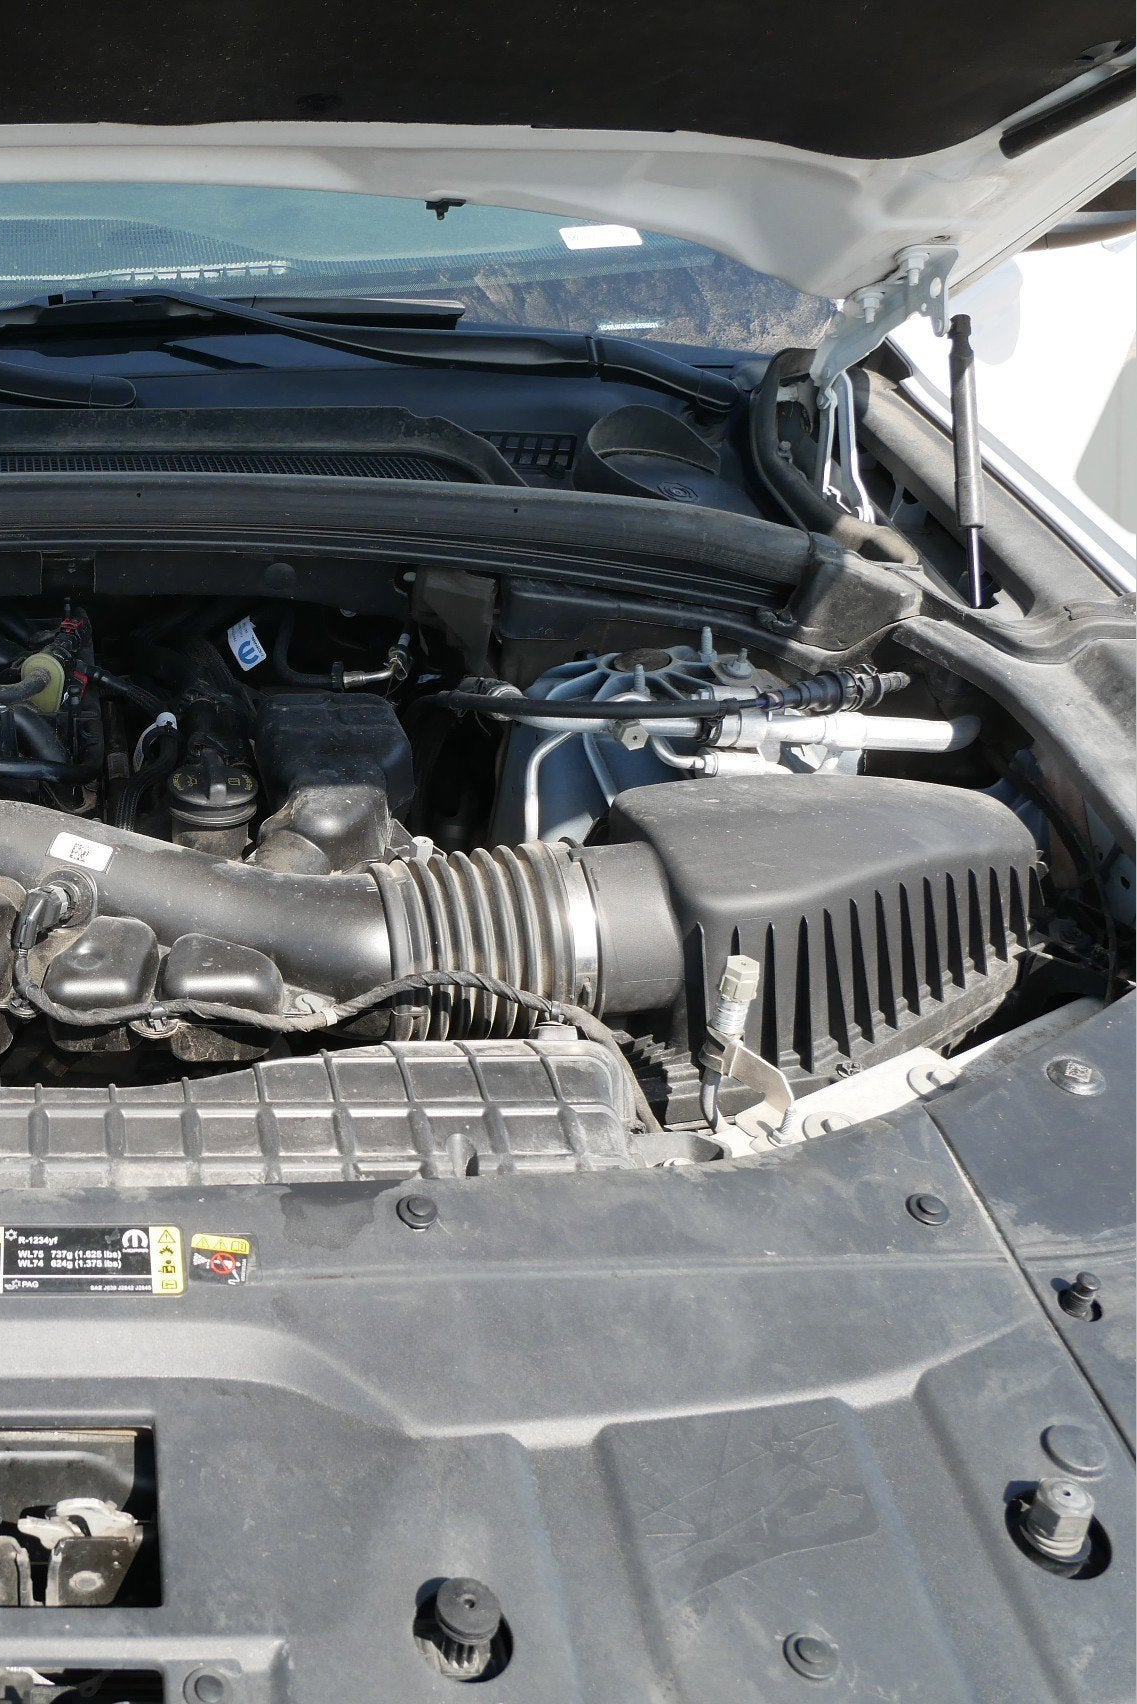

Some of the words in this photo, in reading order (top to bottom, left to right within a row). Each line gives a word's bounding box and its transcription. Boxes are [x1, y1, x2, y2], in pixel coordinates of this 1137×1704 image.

[18, 1236, 58, 1246] R-1234yf
[18, 1250, 44, 1259] WL75
[51, 1250, 73, 1260] 737g
[75, 1250, 103, 1260] (1.625
[104, 1250, 122, 1260] lbs)
[18, 1259, 44, 1268] WL74
[51, 1259, 73, 1269] 624g
[75, 1259, 103, 1269] (1.375
[104, 1259, 122, 1269] lbs)
[21, 1280, 39, 1288] PAG
